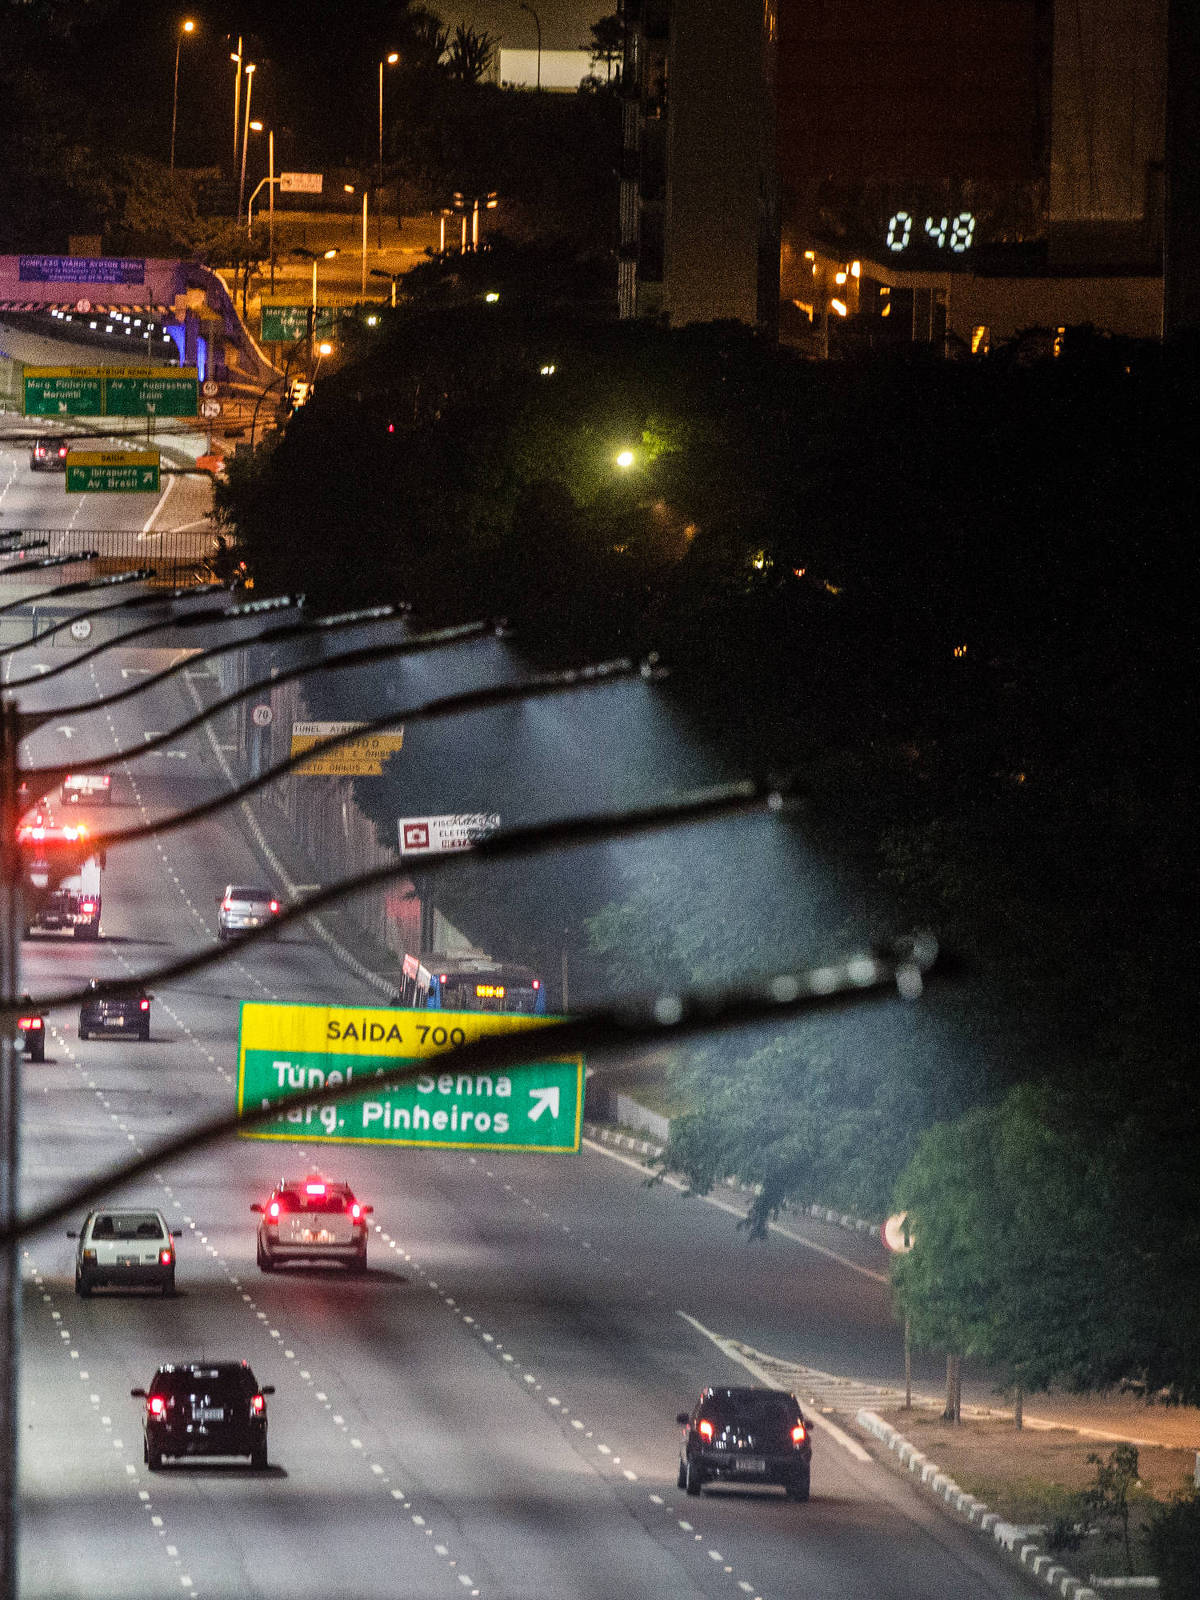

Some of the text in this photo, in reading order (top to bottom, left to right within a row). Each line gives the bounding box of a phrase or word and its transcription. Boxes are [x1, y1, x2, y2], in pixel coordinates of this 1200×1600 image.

[55, 380, 98, 389] Pinheiros
[43, 390, 82, 398] Morumbi
[91, 468, 138, 477] Ibirapuera
[108, 479, 138, 487] Brasil
[258, 710, 268, 719] 70
[415, 1024, 466, 1047] 700
[273, 1060, 353, 1089] Túnel
[416, 1074, 513, 1098] Senna
[262, 1098, 510, 1135] arg. Pinheiros
